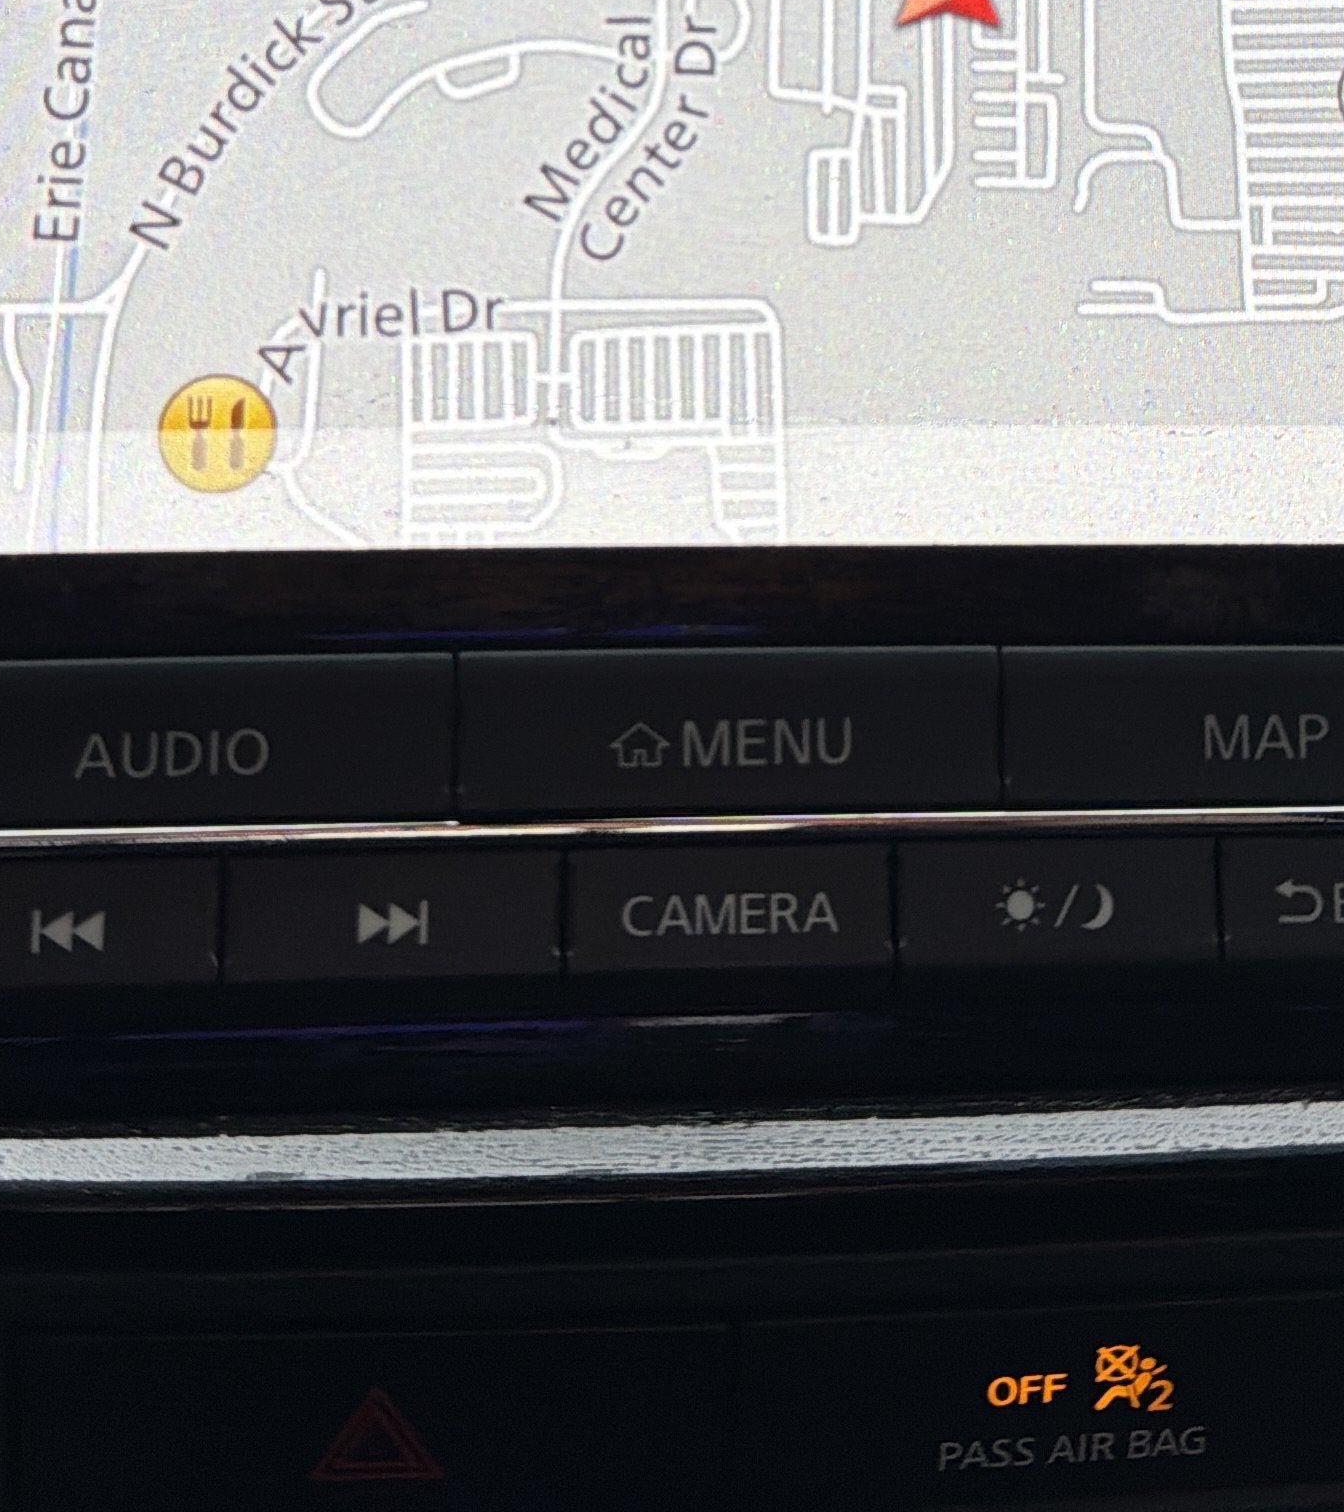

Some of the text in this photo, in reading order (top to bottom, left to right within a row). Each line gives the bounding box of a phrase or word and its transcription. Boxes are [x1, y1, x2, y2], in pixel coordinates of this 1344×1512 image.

[130, 201, 182, 250] N
[158, 14, 312, 194] Burdick
[523, 14, 652, 223] Medical
[581, 12, 720, 260] Center Dr
[34, 140, 83, 243] Erie
[442, 288, 505, 331] Dr
[74, 728, 270, 779] AUDIO
[682, 717, 854, 767] MENU
[1202, 713, 1331, 761] MAP
[621, 891, 840, 937] CAMERA
[986, 1372, 1069, 1407] OFF
[938, 1425, 1207, 1472] PASS AIR BAG
